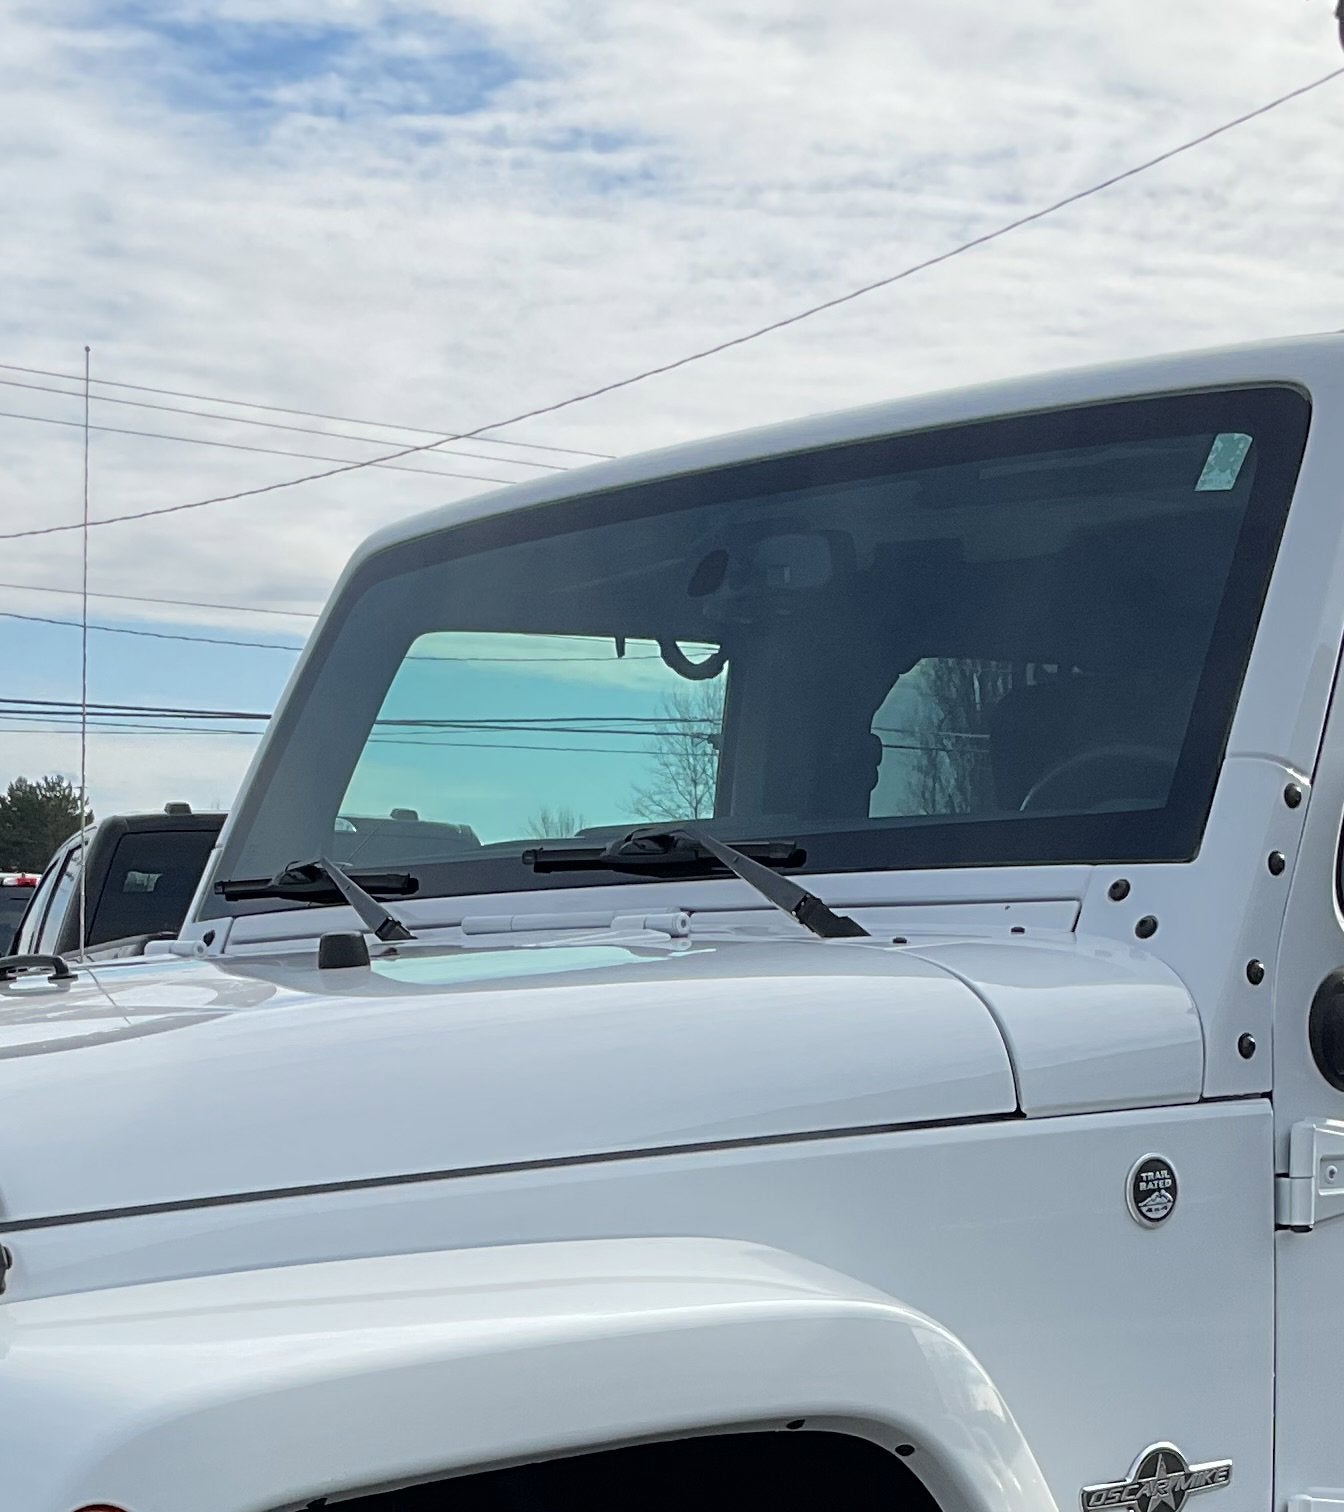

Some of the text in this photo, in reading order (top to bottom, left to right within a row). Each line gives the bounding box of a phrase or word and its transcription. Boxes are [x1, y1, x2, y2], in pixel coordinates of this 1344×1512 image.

[1140, 1170, 1171, 1181] TRAIL
[1139, 1179, 1172, 1191] RATED
[1089, 1465, 1230, 1506] OSCAR MIKE
